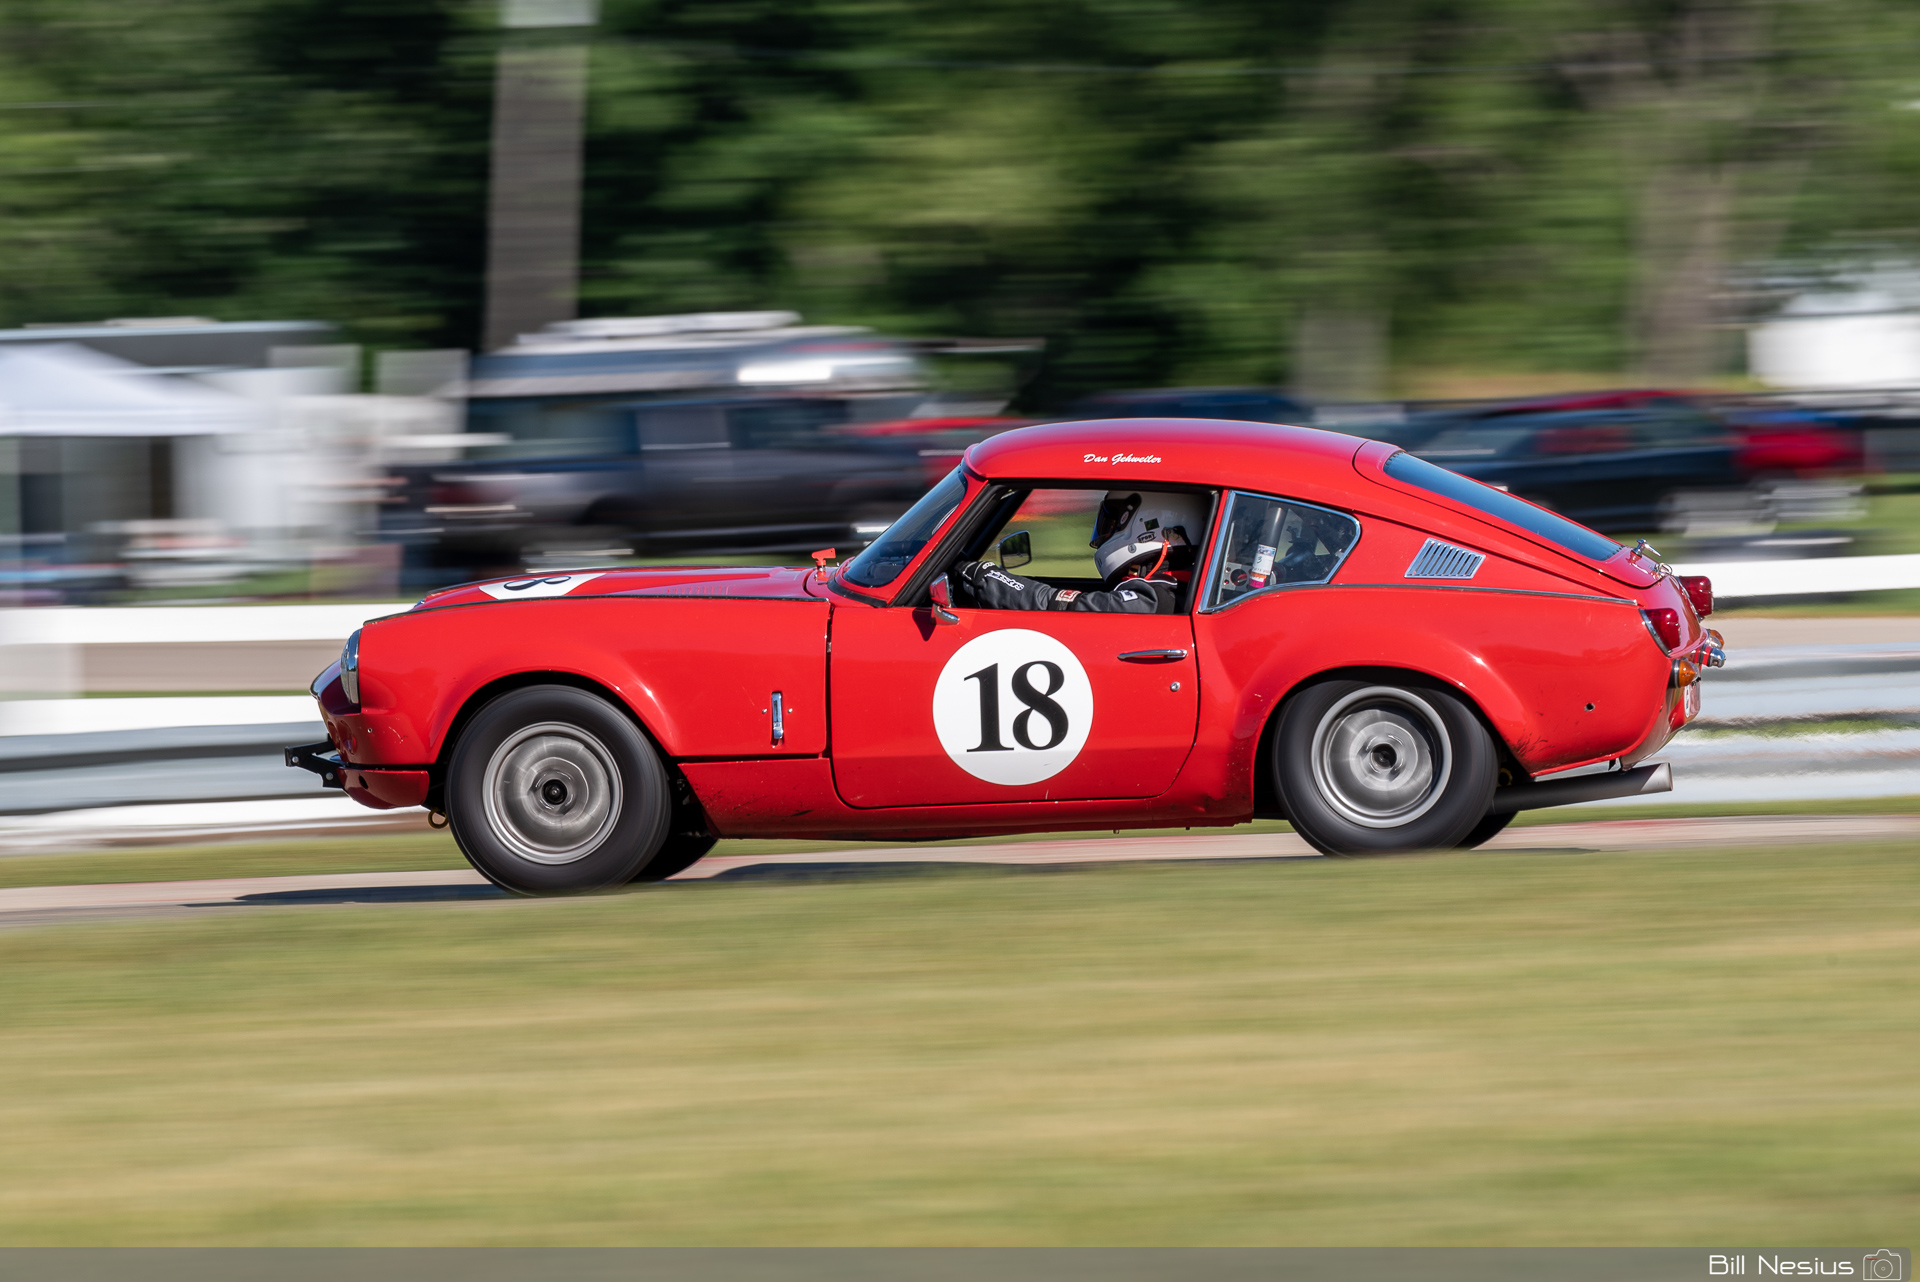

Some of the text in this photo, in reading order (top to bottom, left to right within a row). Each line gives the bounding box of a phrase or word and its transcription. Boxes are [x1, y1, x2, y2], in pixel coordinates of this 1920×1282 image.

[1083, 453, 1162, 466] Dan Gehweiler
[963, 660, 1069, 752] 18
